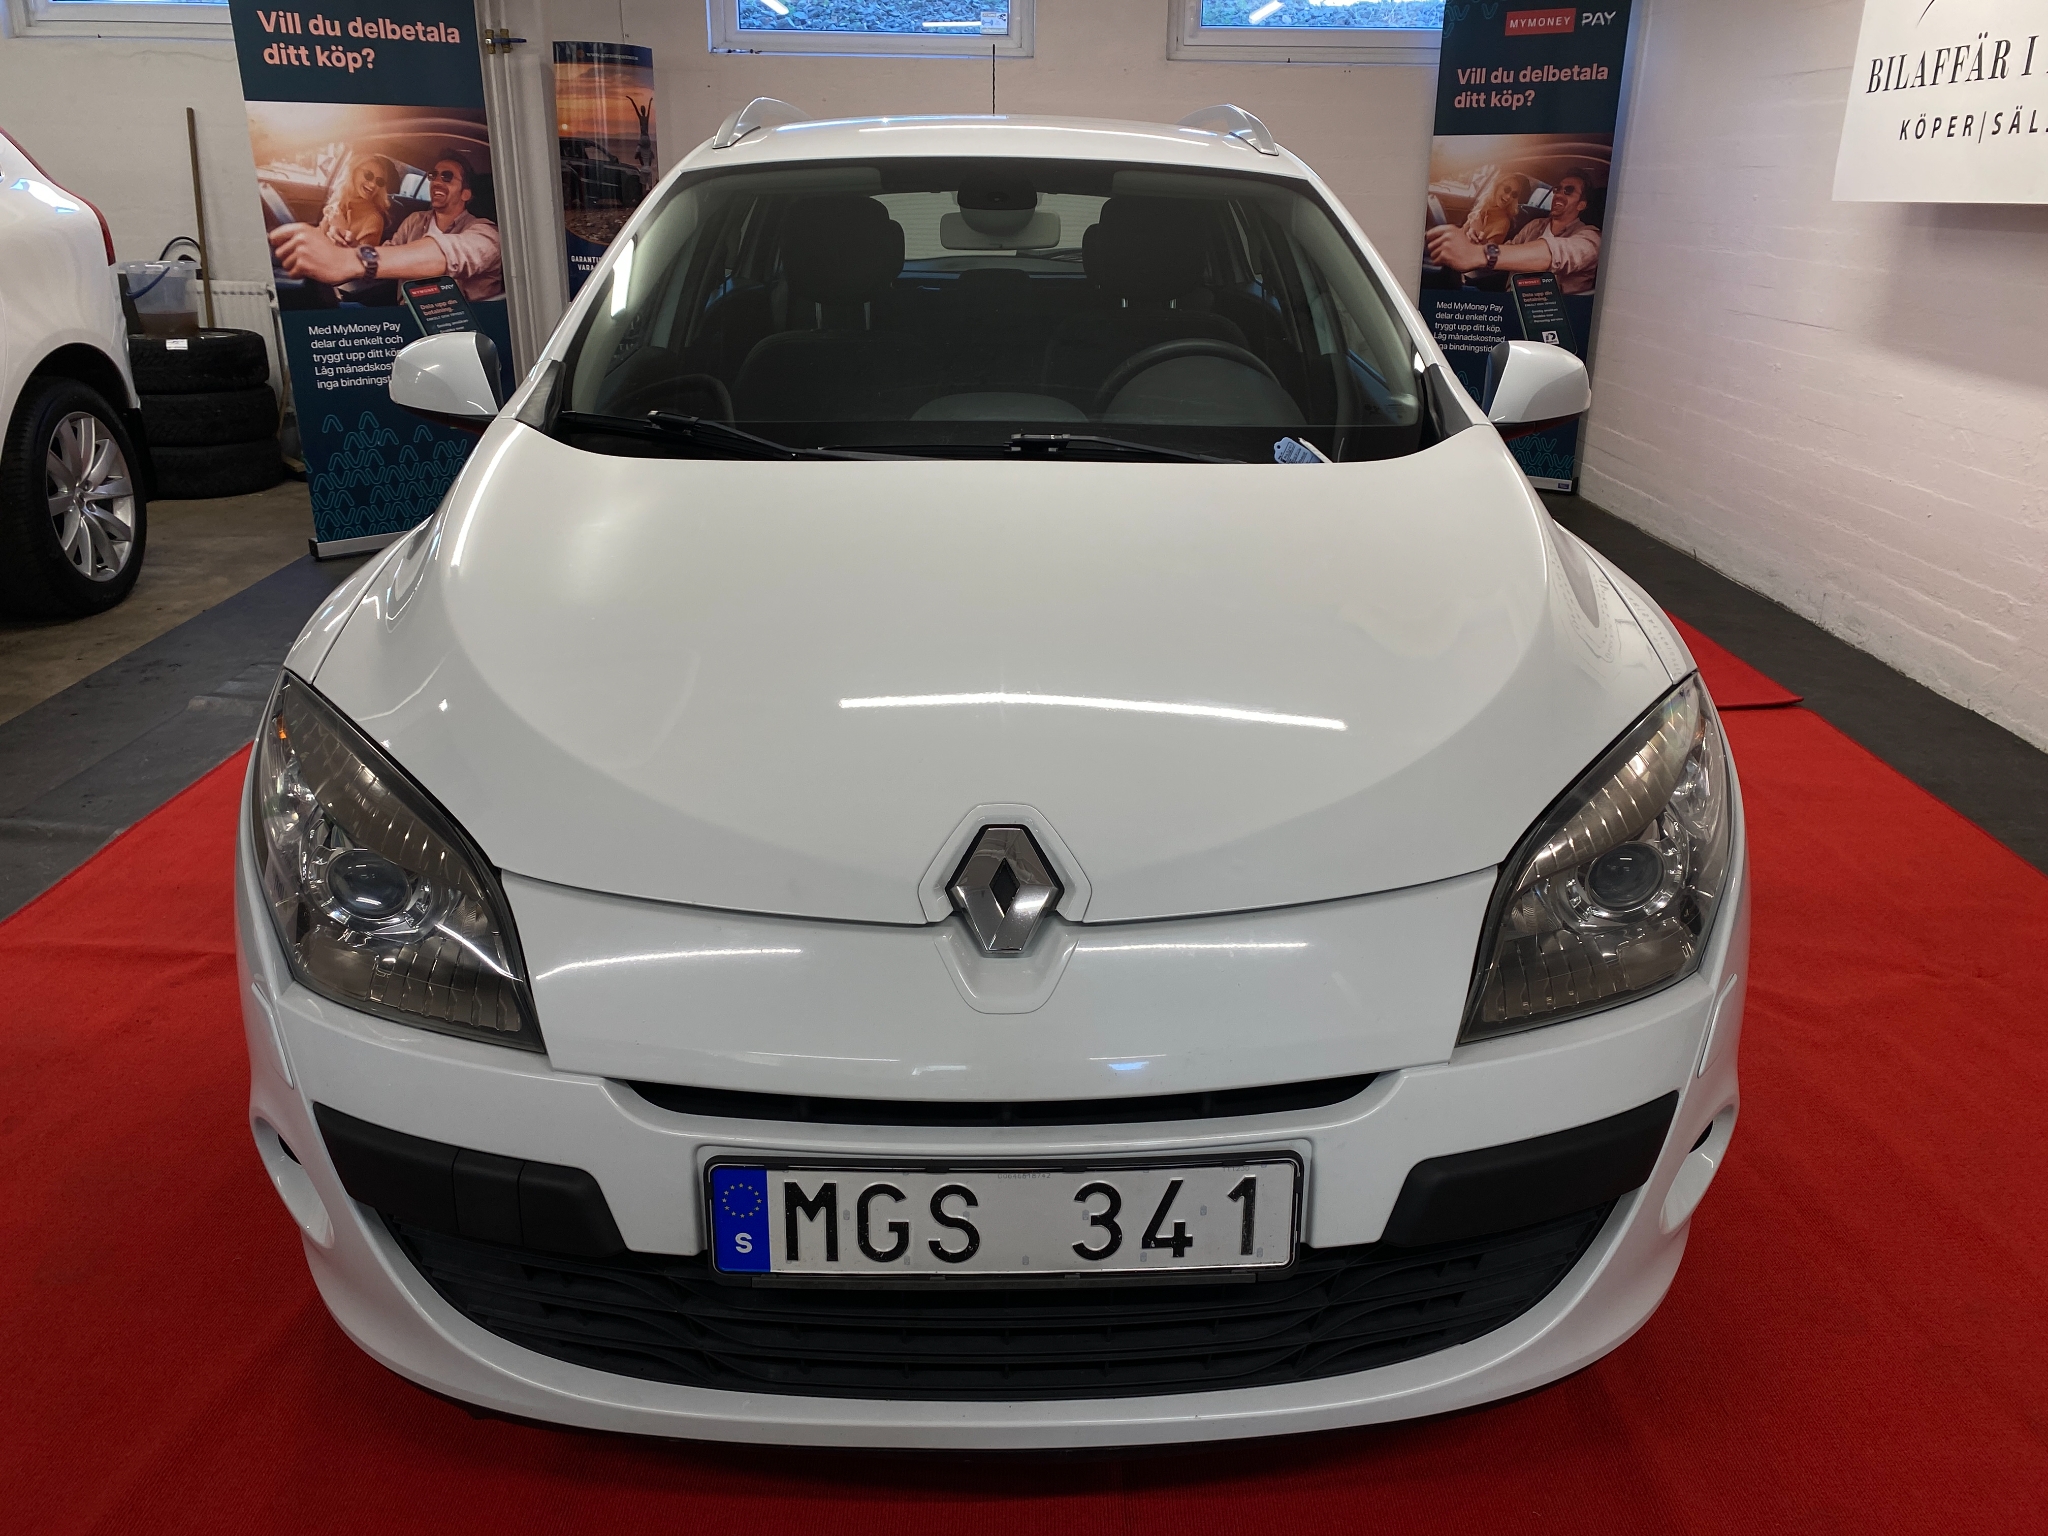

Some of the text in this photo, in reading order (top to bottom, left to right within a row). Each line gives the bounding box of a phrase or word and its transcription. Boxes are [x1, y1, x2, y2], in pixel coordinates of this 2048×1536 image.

[256, 10, 460, 43] Vill du delbetala
[1509, 11, 1617, 29] MYMONEY PAY
[263, 43, 375, 73] ditt köp?
[1865, 31, 2040, 94] BILAFFÄR I
[1457, 63, 1609, 85] Vill du delbetala
[1454, 89, 1535, 110] ditt köp?
[1436, 301, 1504, 313] Med MyMoney Pay
[1465, 313, 1488, 321] enkelt
[1488, 314, 1503, 322] och
[308, 322, 401, 335] Med MyMoney Pay
[1434, 322, 1457, 331] tryggt
[1457, 324, 1472, 332] upp
[1486, 324, 1502, 333] köp.
[311, 335, 403, 349] delar du enkelt och
[1433, 332, 1506, 343] Låg månadskostnad
[312, 352, 344, 363] tryggt
[346, 351, 365, 361] upp
[367, 349, 383, 358] ditt
[315, 366, 334, 377] Låg
[317, 380, 339, 390] inga
[784, 1174, 1258, 1263] MGS 341
[735, 1232, 753, 1254] S
